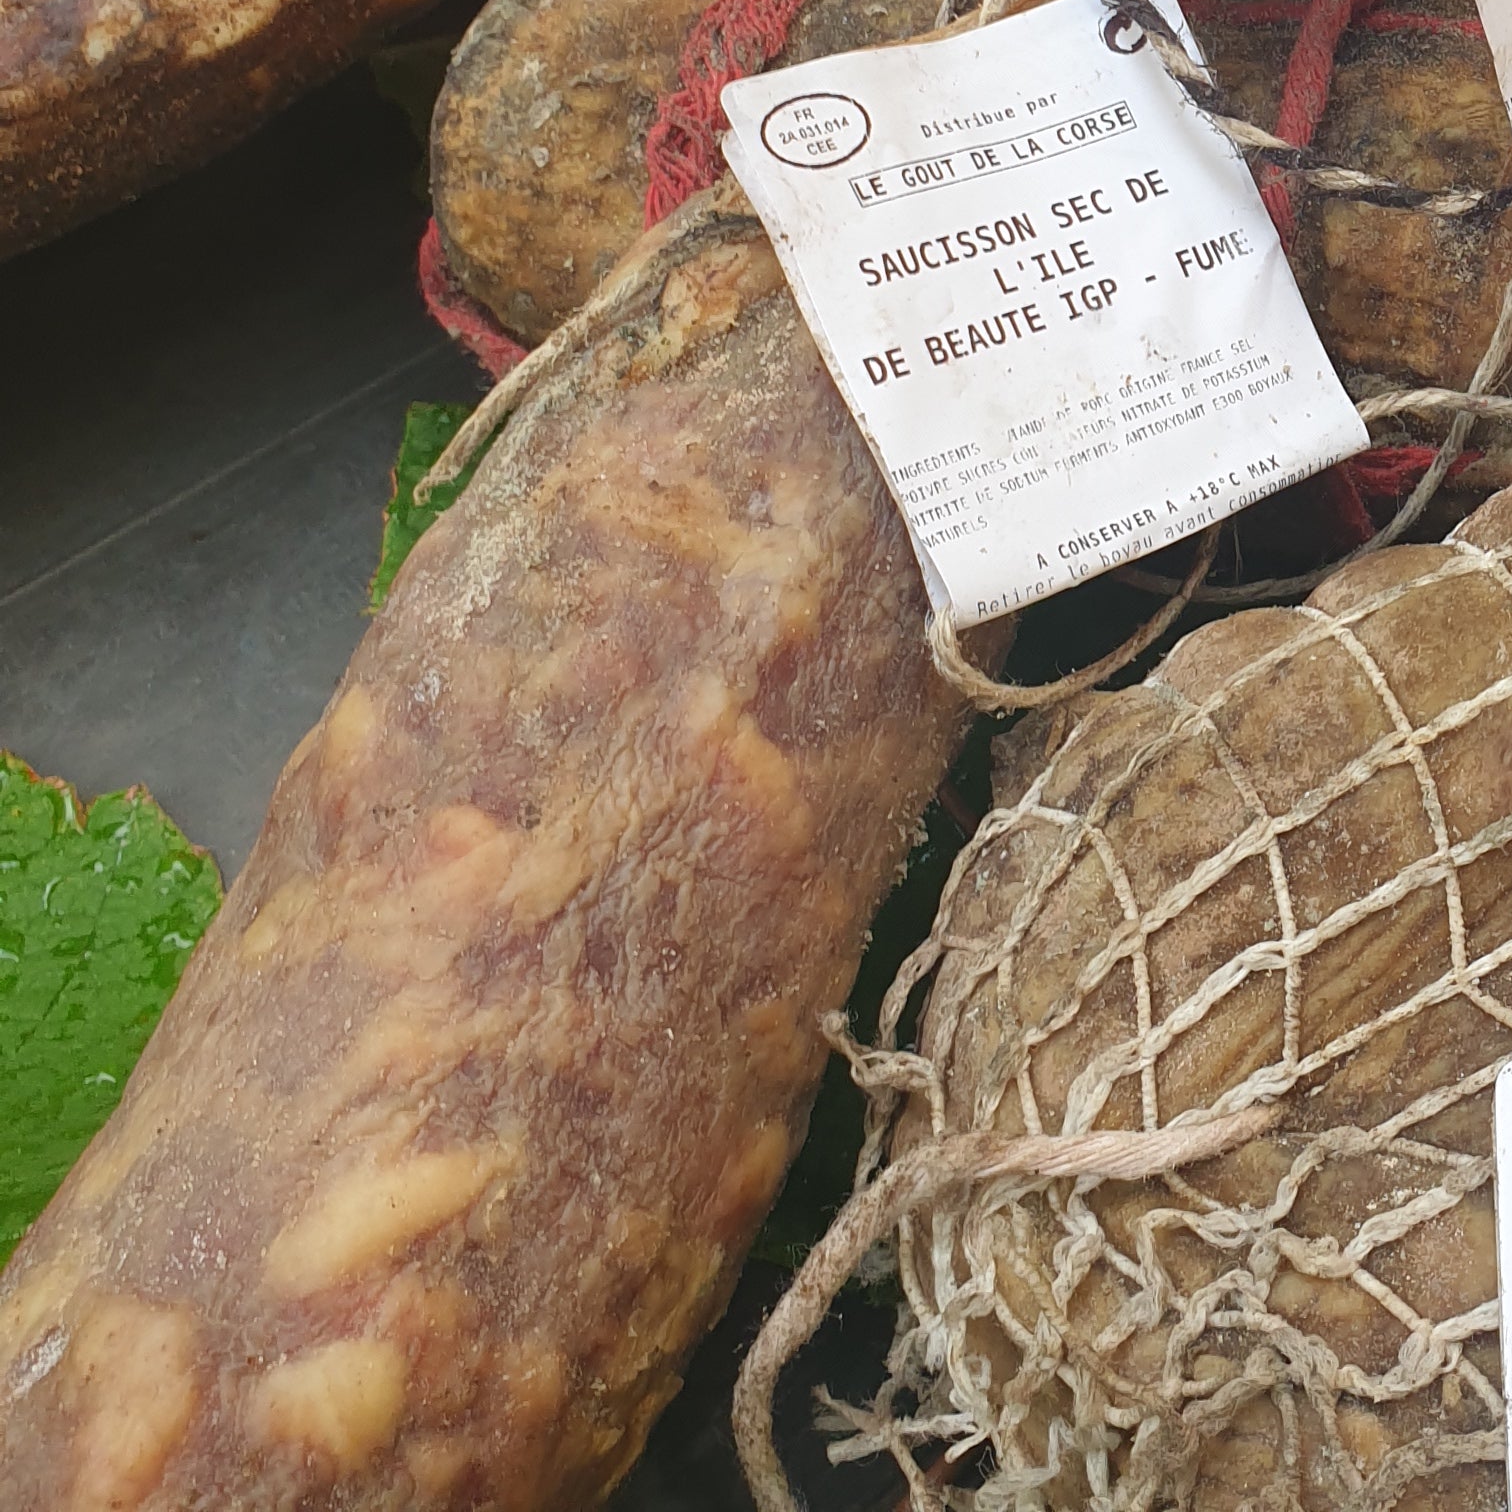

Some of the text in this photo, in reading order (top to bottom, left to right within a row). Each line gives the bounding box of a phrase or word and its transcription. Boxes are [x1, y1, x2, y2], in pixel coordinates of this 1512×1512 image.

[778, 116, 850, 145] 2A031.014
[793, 107, 815, 123] FR
[807, 138, 838, 157] CEE
[854, 105, 1133, 202] LE GOUT DE LA CORSE
[920, 92, 1059, 139] Distribue par
[858, 169, 1169, 287] SAUCISSON SEC DE
[992, 240, 1096, 295] L'ILE
[862, 347, 912, 386] DE
[924, 304, 1047, 366] BEAUTE
[1059, 278, 1119, 321] IGP
[1175, 228, 1254, 278] FUME
[891, 442, 981, 485] INGREDIENTS
[1180, 349, 1225, 375] FRANCE
[1230, 337, 1254, 356] SEL
[911, 496, 971, 529] NITRITE
[1000, 468, 1050, 495] SODIUM
[1125, 403, 1206, 446] ANTIOXYDANT
[1212, 389, 1244, 412] E300
[1248, 371, 1293, 397] BOYAUX
[958, 457, 1008, 486] SUCRES
[1121, 392, 1177, 423] NITRATE
[1181, 382, 1199, 400] DE
[1203, 354, 1271, 391] POTASSIUM
[922, 515, 988, 549] NATURELS
[976, 576, 1055, 619] Retirer
[1068, 563, 1089, 582] le
[1164, 506, 1217, 540] avant
[1037, 553, 1049, 571] A
[1058, 508, 1157, 560] CONSERVER
[1165, 498, 1178, 514] A
[1247, 454, 1281, 480] MAX
